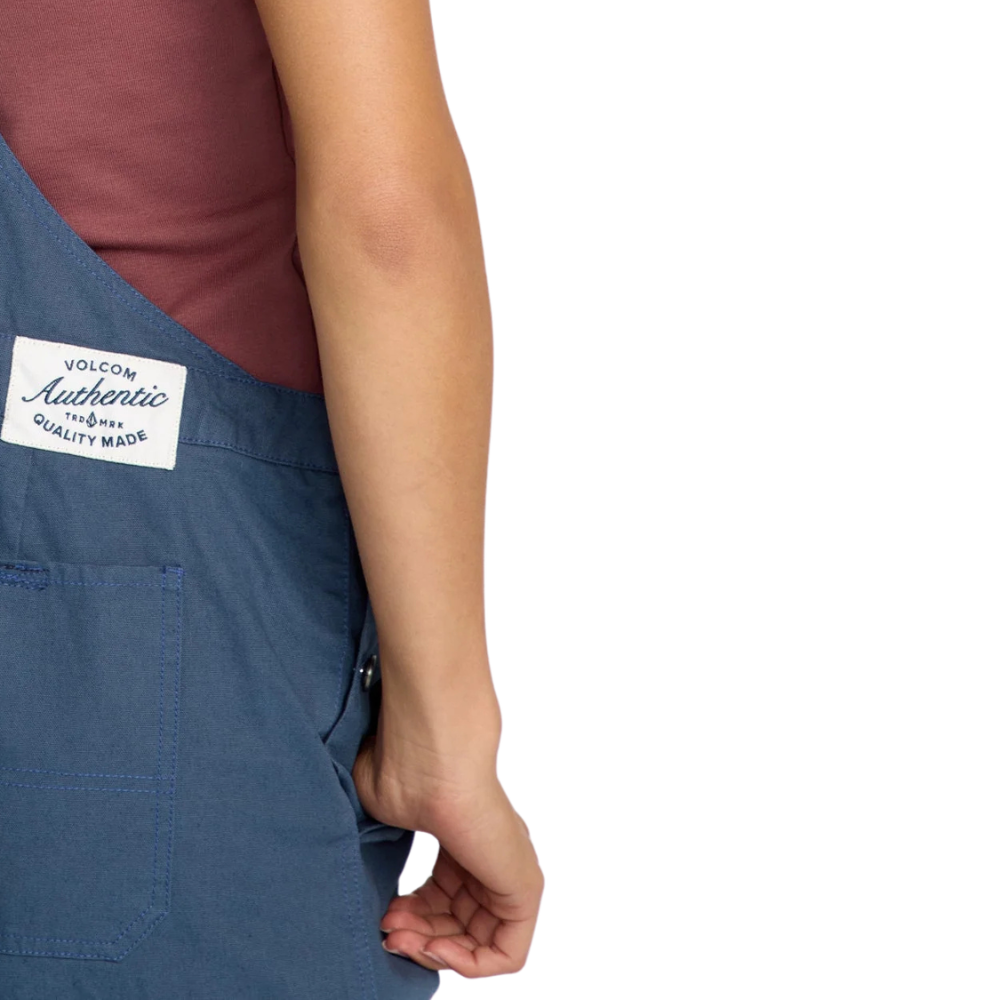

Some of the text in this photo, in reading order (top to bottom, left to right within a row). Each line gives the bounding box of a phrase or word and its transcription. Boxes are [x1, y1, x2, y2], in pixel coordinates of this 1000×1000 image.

[64, 359, 137, 382] VOLCOM
[22, 376, 169, 407] Authentic
[33, 413, 148, 448] QUALITY MADE
[65, 412, 124, 429] TRD MRK
